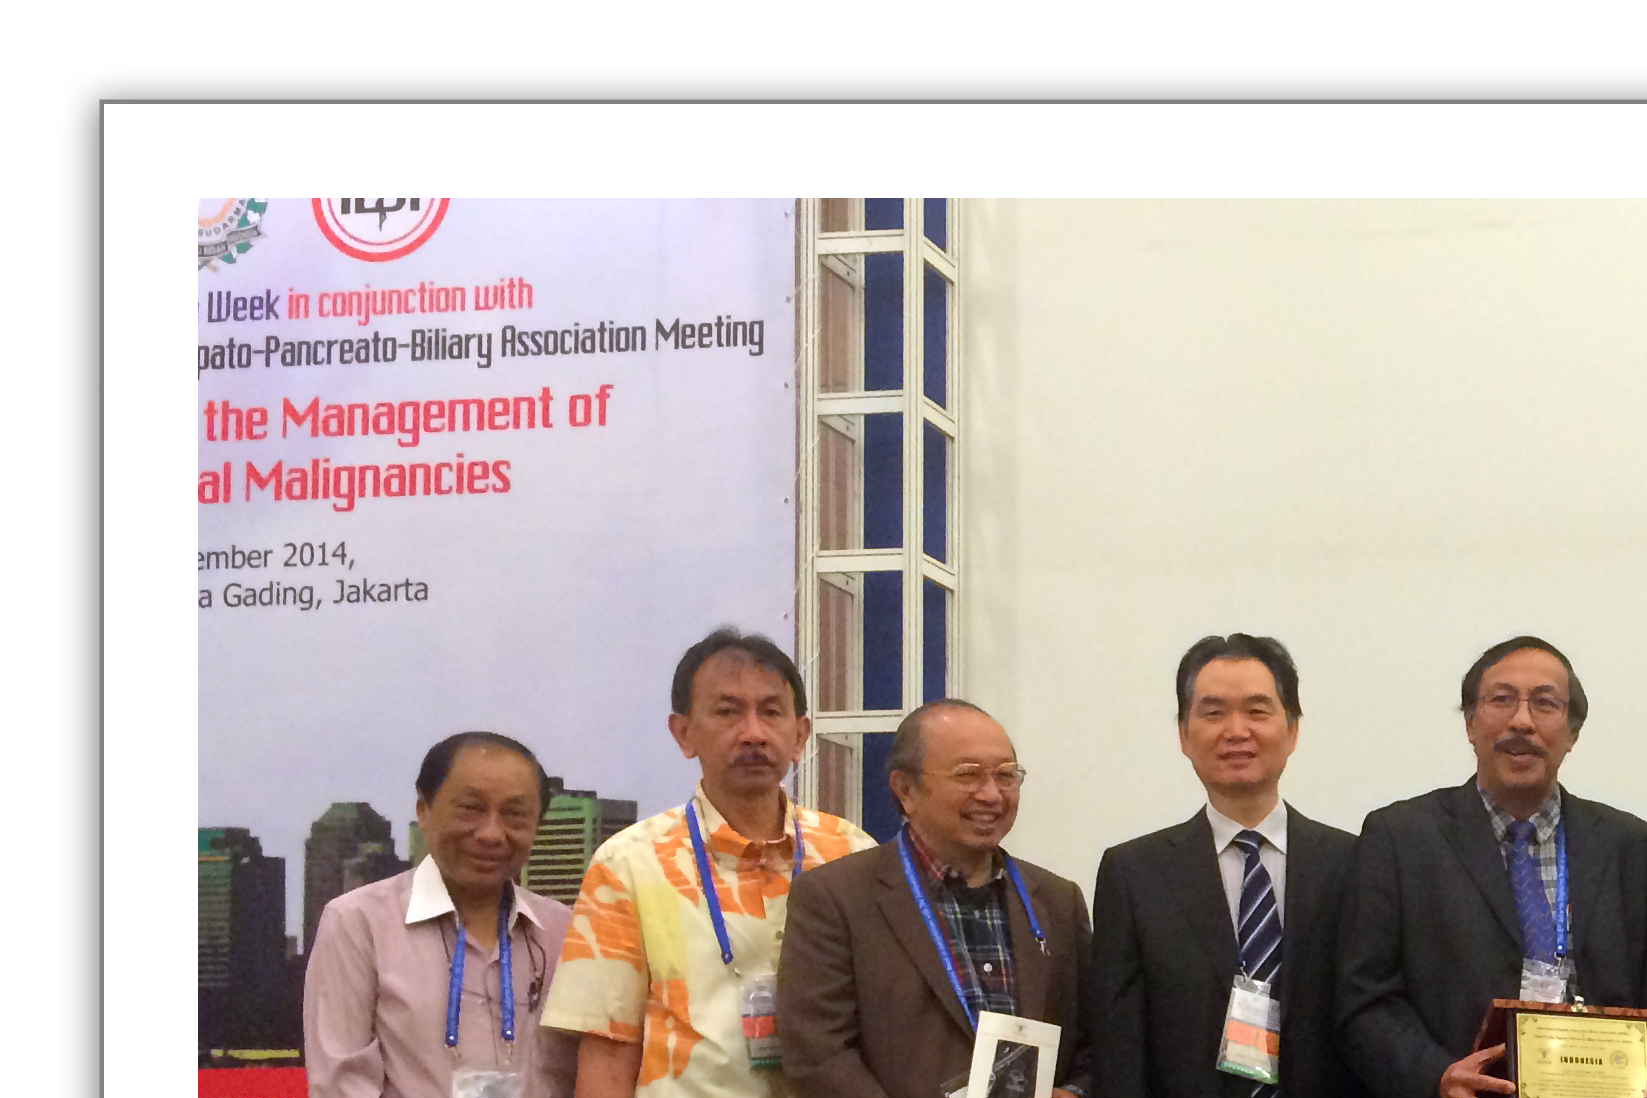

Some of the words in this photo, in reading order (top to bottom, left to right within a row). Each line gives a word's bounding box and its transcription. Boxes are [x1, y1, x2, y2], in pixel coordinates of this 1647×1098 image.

[207, 289, 280, 322] Week
[287, 287, 310, 319] in
[317, 281, 466, 326] conjunction
[474, 277, 533, 311] with
[501, 321, 647, 358] Association
[655, 315, 764, 356] Meeting
[203, 400, 268, 441] the
[281, 386, 554, 447] Management
[568, 384, 614, 427] of
[245, 452, 512, 512] Malignancies
[283, 541, 355, 570] 2014,
[223, 581, 322, 611] Gading,
[333, 578, 429, 604] Jakarta
